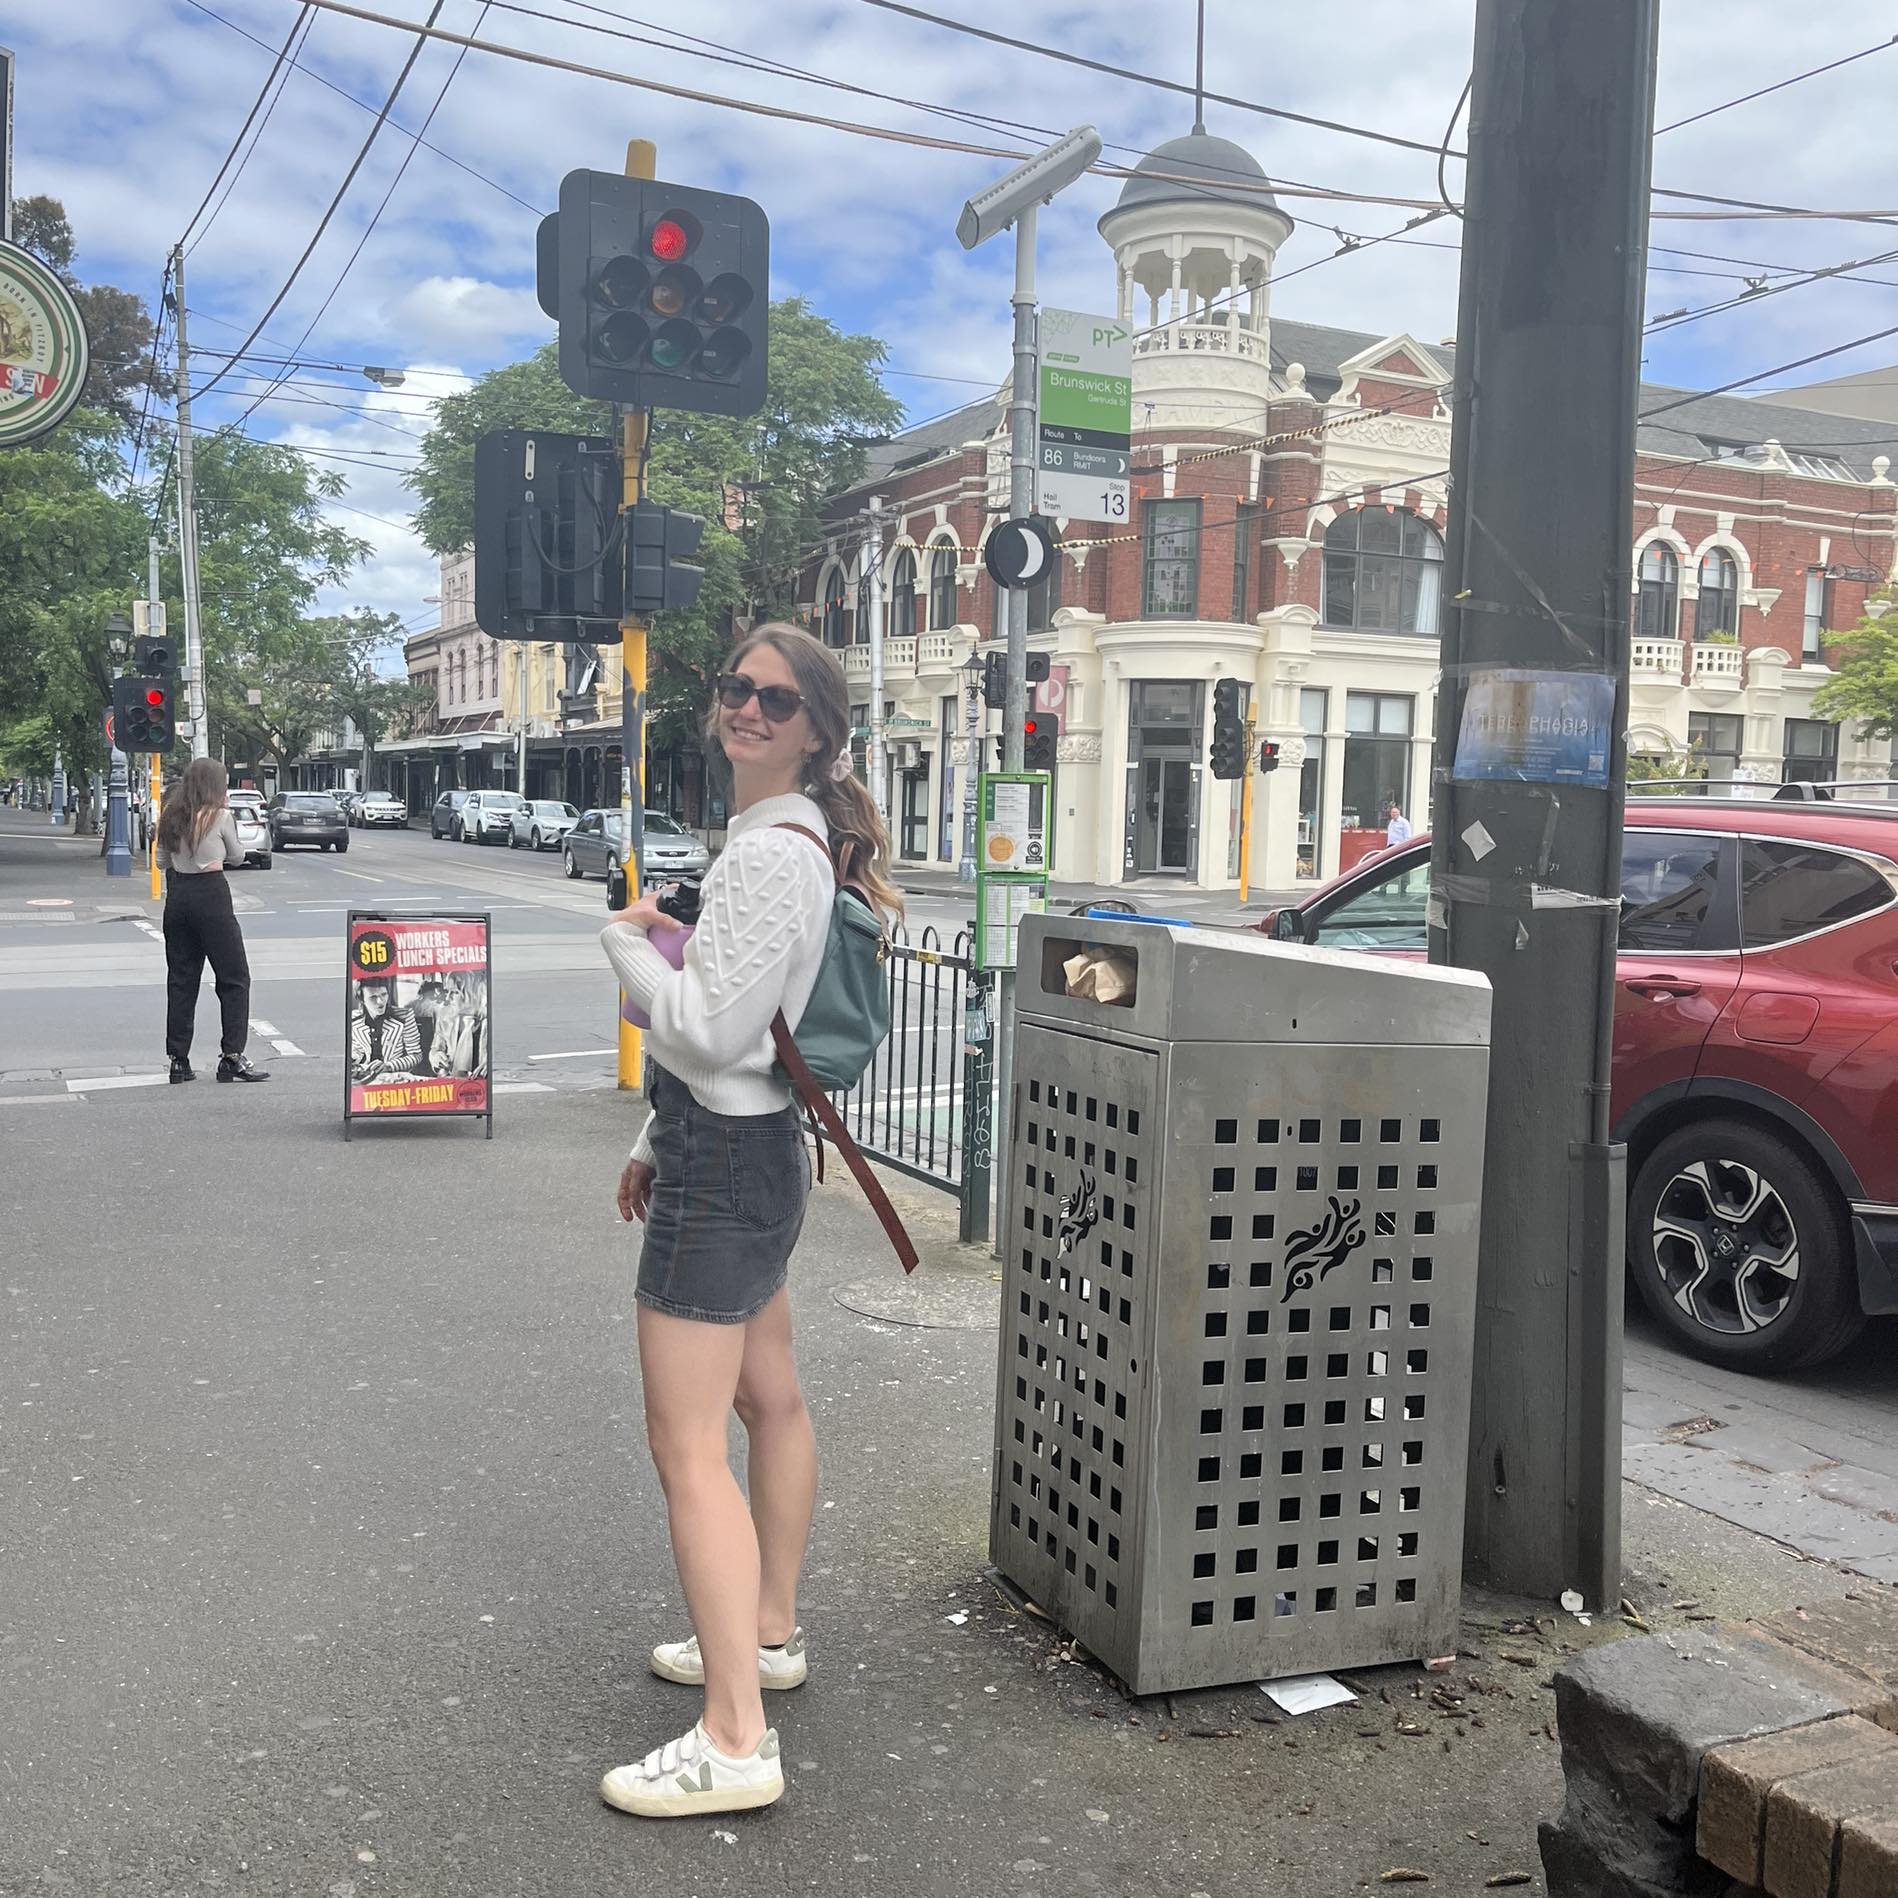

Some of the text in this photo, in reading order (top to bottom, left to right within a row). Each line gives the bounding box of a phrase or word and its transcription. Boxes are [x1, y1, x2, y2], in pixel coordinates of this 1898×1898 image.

[1050, 372, 1127, 396] Brunswick St
[1119, 396, 1127, 407] St
[1044, 428, 1082, 441] Route To
[1044, 448, 1063, 466] 86
[1073, 451, 1106, 463] Bundoora
[1073, 461, 1092, 470] RMIT
[1109, 482, 1125, 492] Stop
[1043, 492, 1057, 501] Hail
[1100, 492, 1125, 516] 13
[1043, 501, 1061, 510] Tram
[395, 930, 450, 950] WORKERS
[360, 940, 387, 966] $15
[397, 945, 487, 968] LUNCH SPECIALS
[363, 1084, 455, 1109] TUESDAY-FRIDAY
